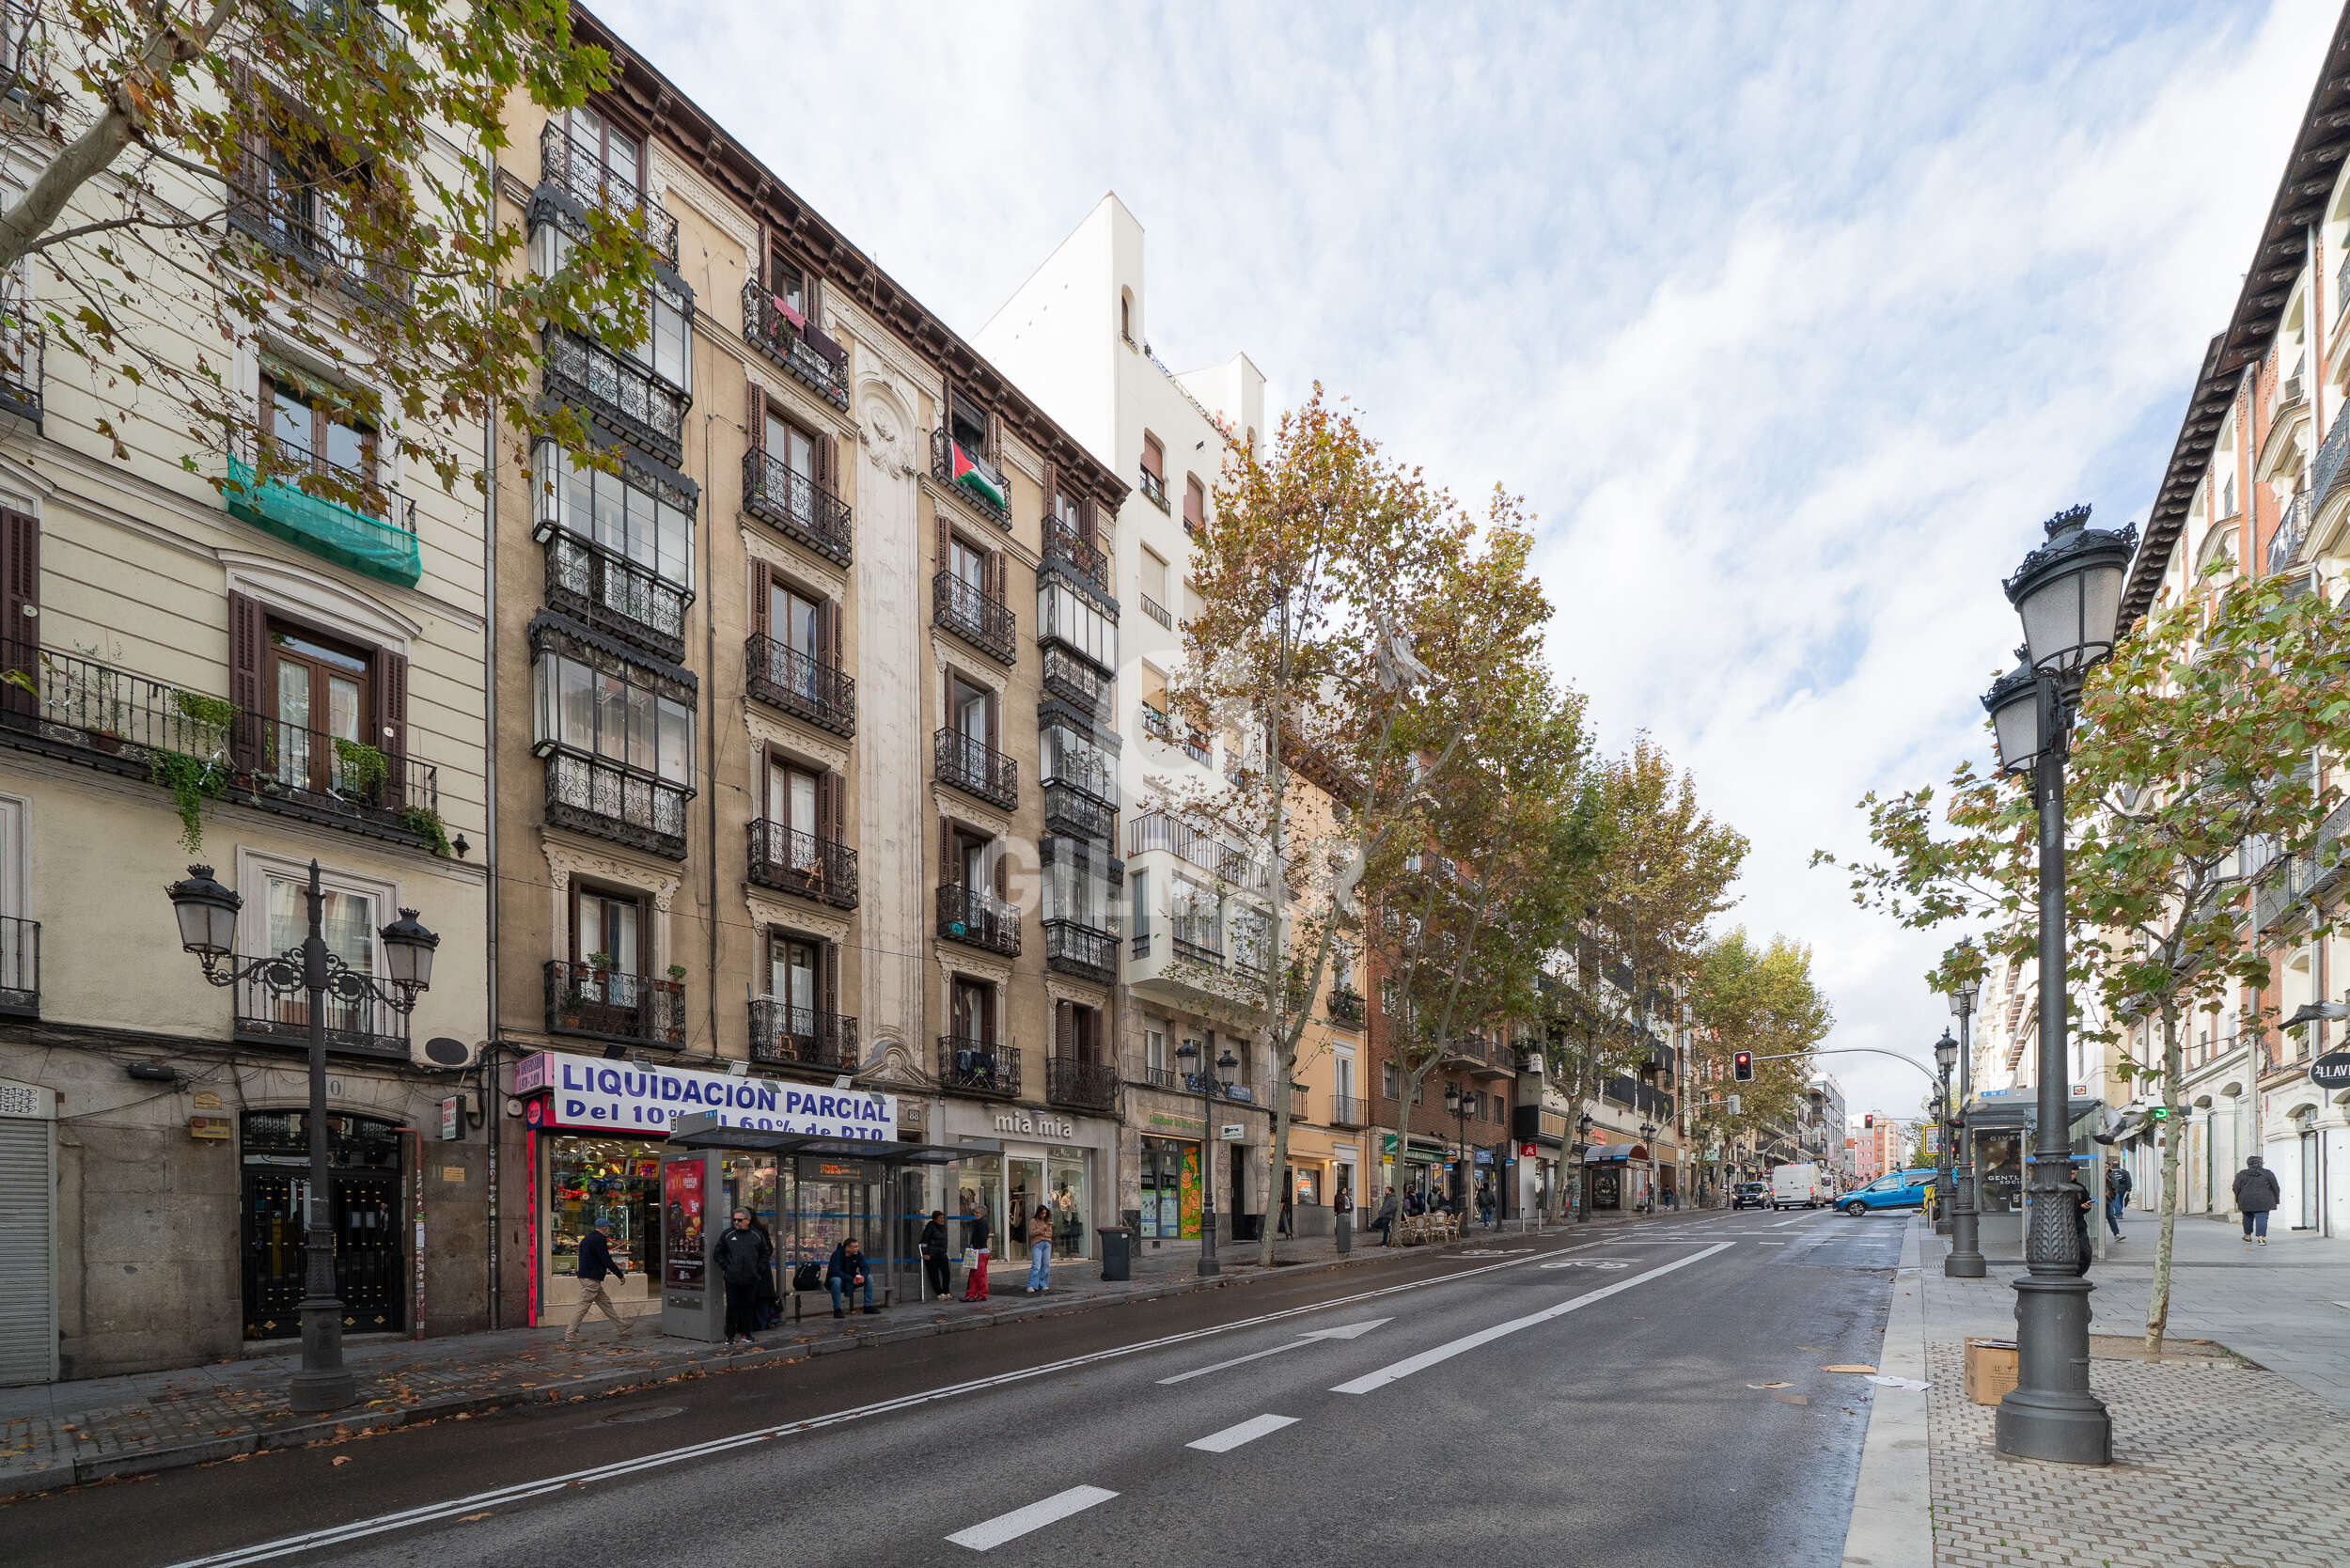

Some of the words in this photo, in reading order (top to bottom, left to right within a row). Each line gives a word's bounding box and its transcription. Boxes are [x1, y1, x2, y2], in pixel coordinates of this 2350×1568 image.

[563, 1063, 776, 1111] LIQUIDACIÓN
[786, 1090, 891, 1123] PARCIAL
[566, 1099, 619, 1121] Del
[909, 1110, 920, 1121] 88
[995, 1111, 1032, 1134] mia
